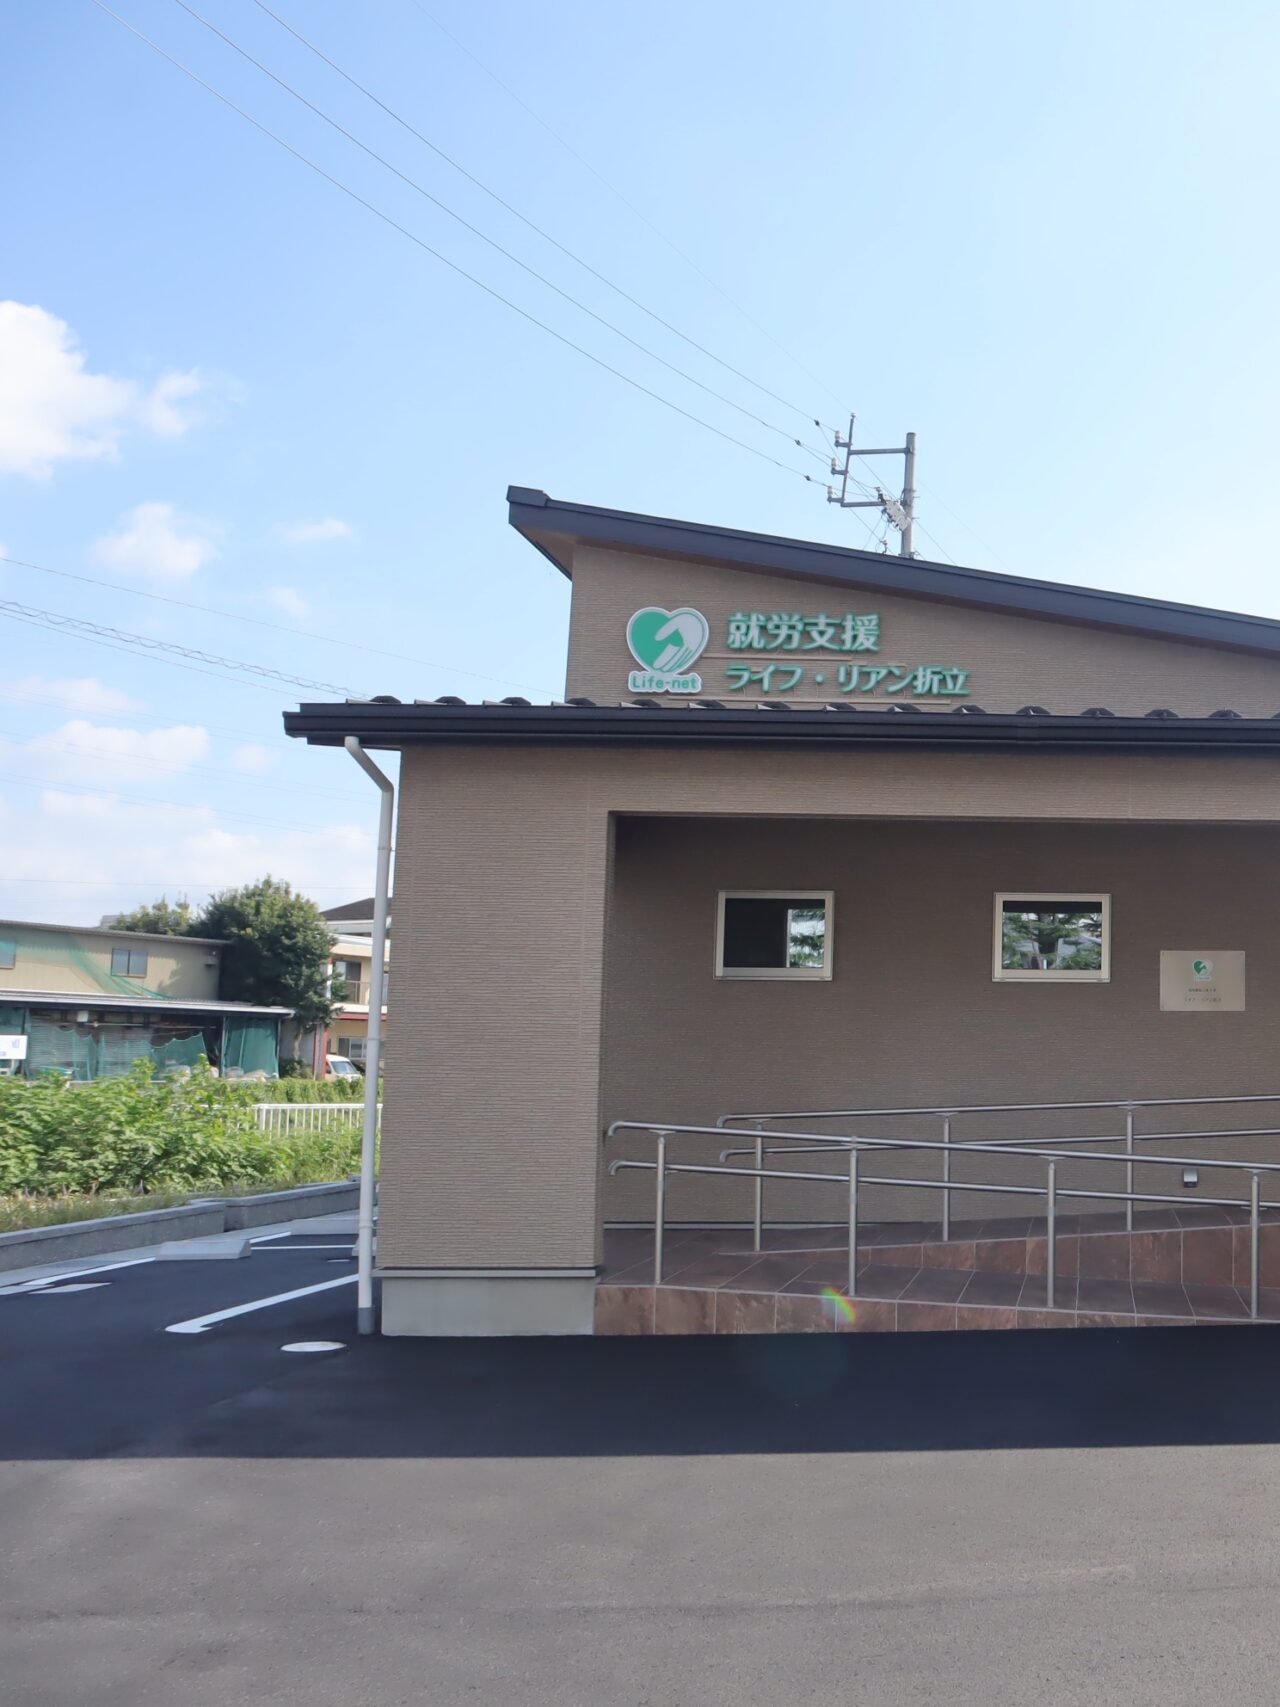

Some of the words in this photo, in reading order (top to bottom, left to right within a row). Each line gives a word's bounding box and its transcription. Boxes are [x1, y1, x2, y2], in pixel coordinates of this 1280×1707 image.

[727, 613, 880, 651] 就労支援
[632, 675, 697, 689] Life-net
[724, 663, 971, 695] ライフ・リアン折立
